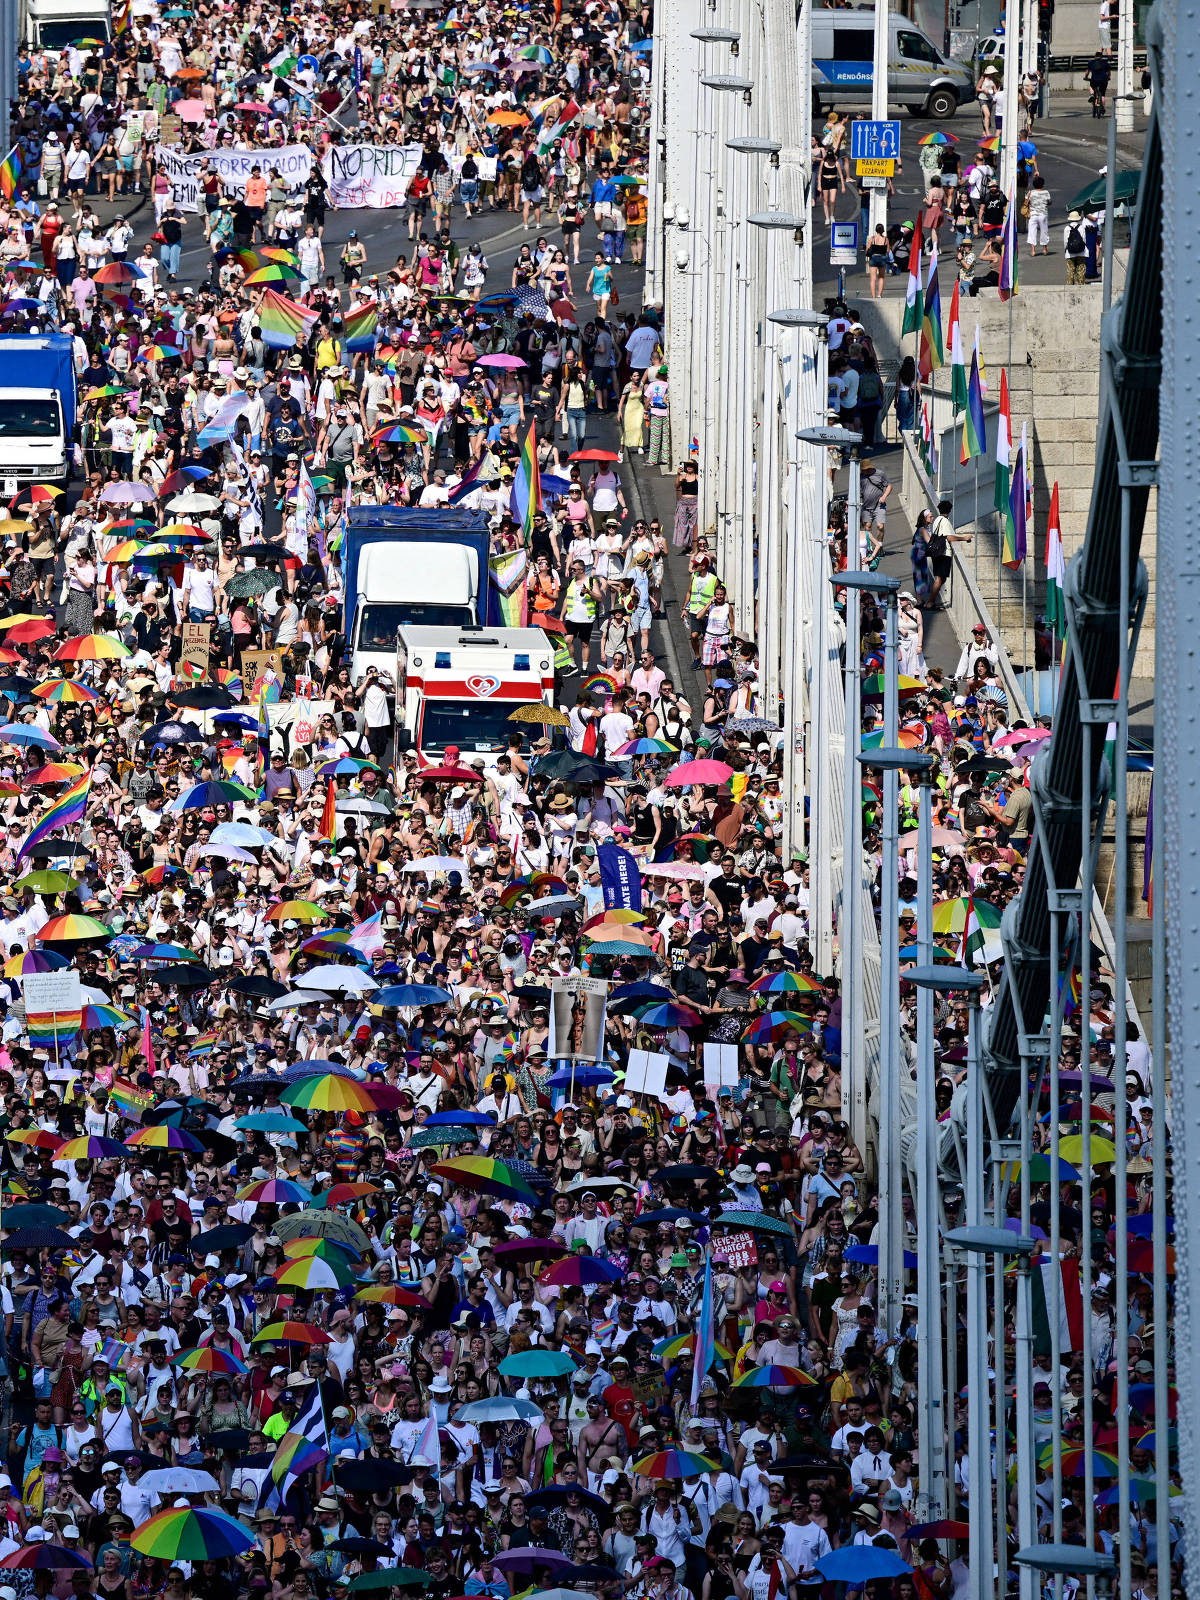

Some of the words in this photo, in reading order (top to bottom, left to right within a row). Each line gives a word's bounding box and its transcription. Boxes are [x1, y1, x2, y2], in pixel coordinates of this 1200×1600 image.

[837, 72, 874, 80] RENDŐRS
[861, 159, 888, 167] RAKPART
[8, 480, 14, 488] 5
[189, 625, 204, 637] EL
[618, 855, 628, 884] HERE!
[621, 885, 632, 911] NATE
[716, 1240, 754, 1254] CHATGPT
